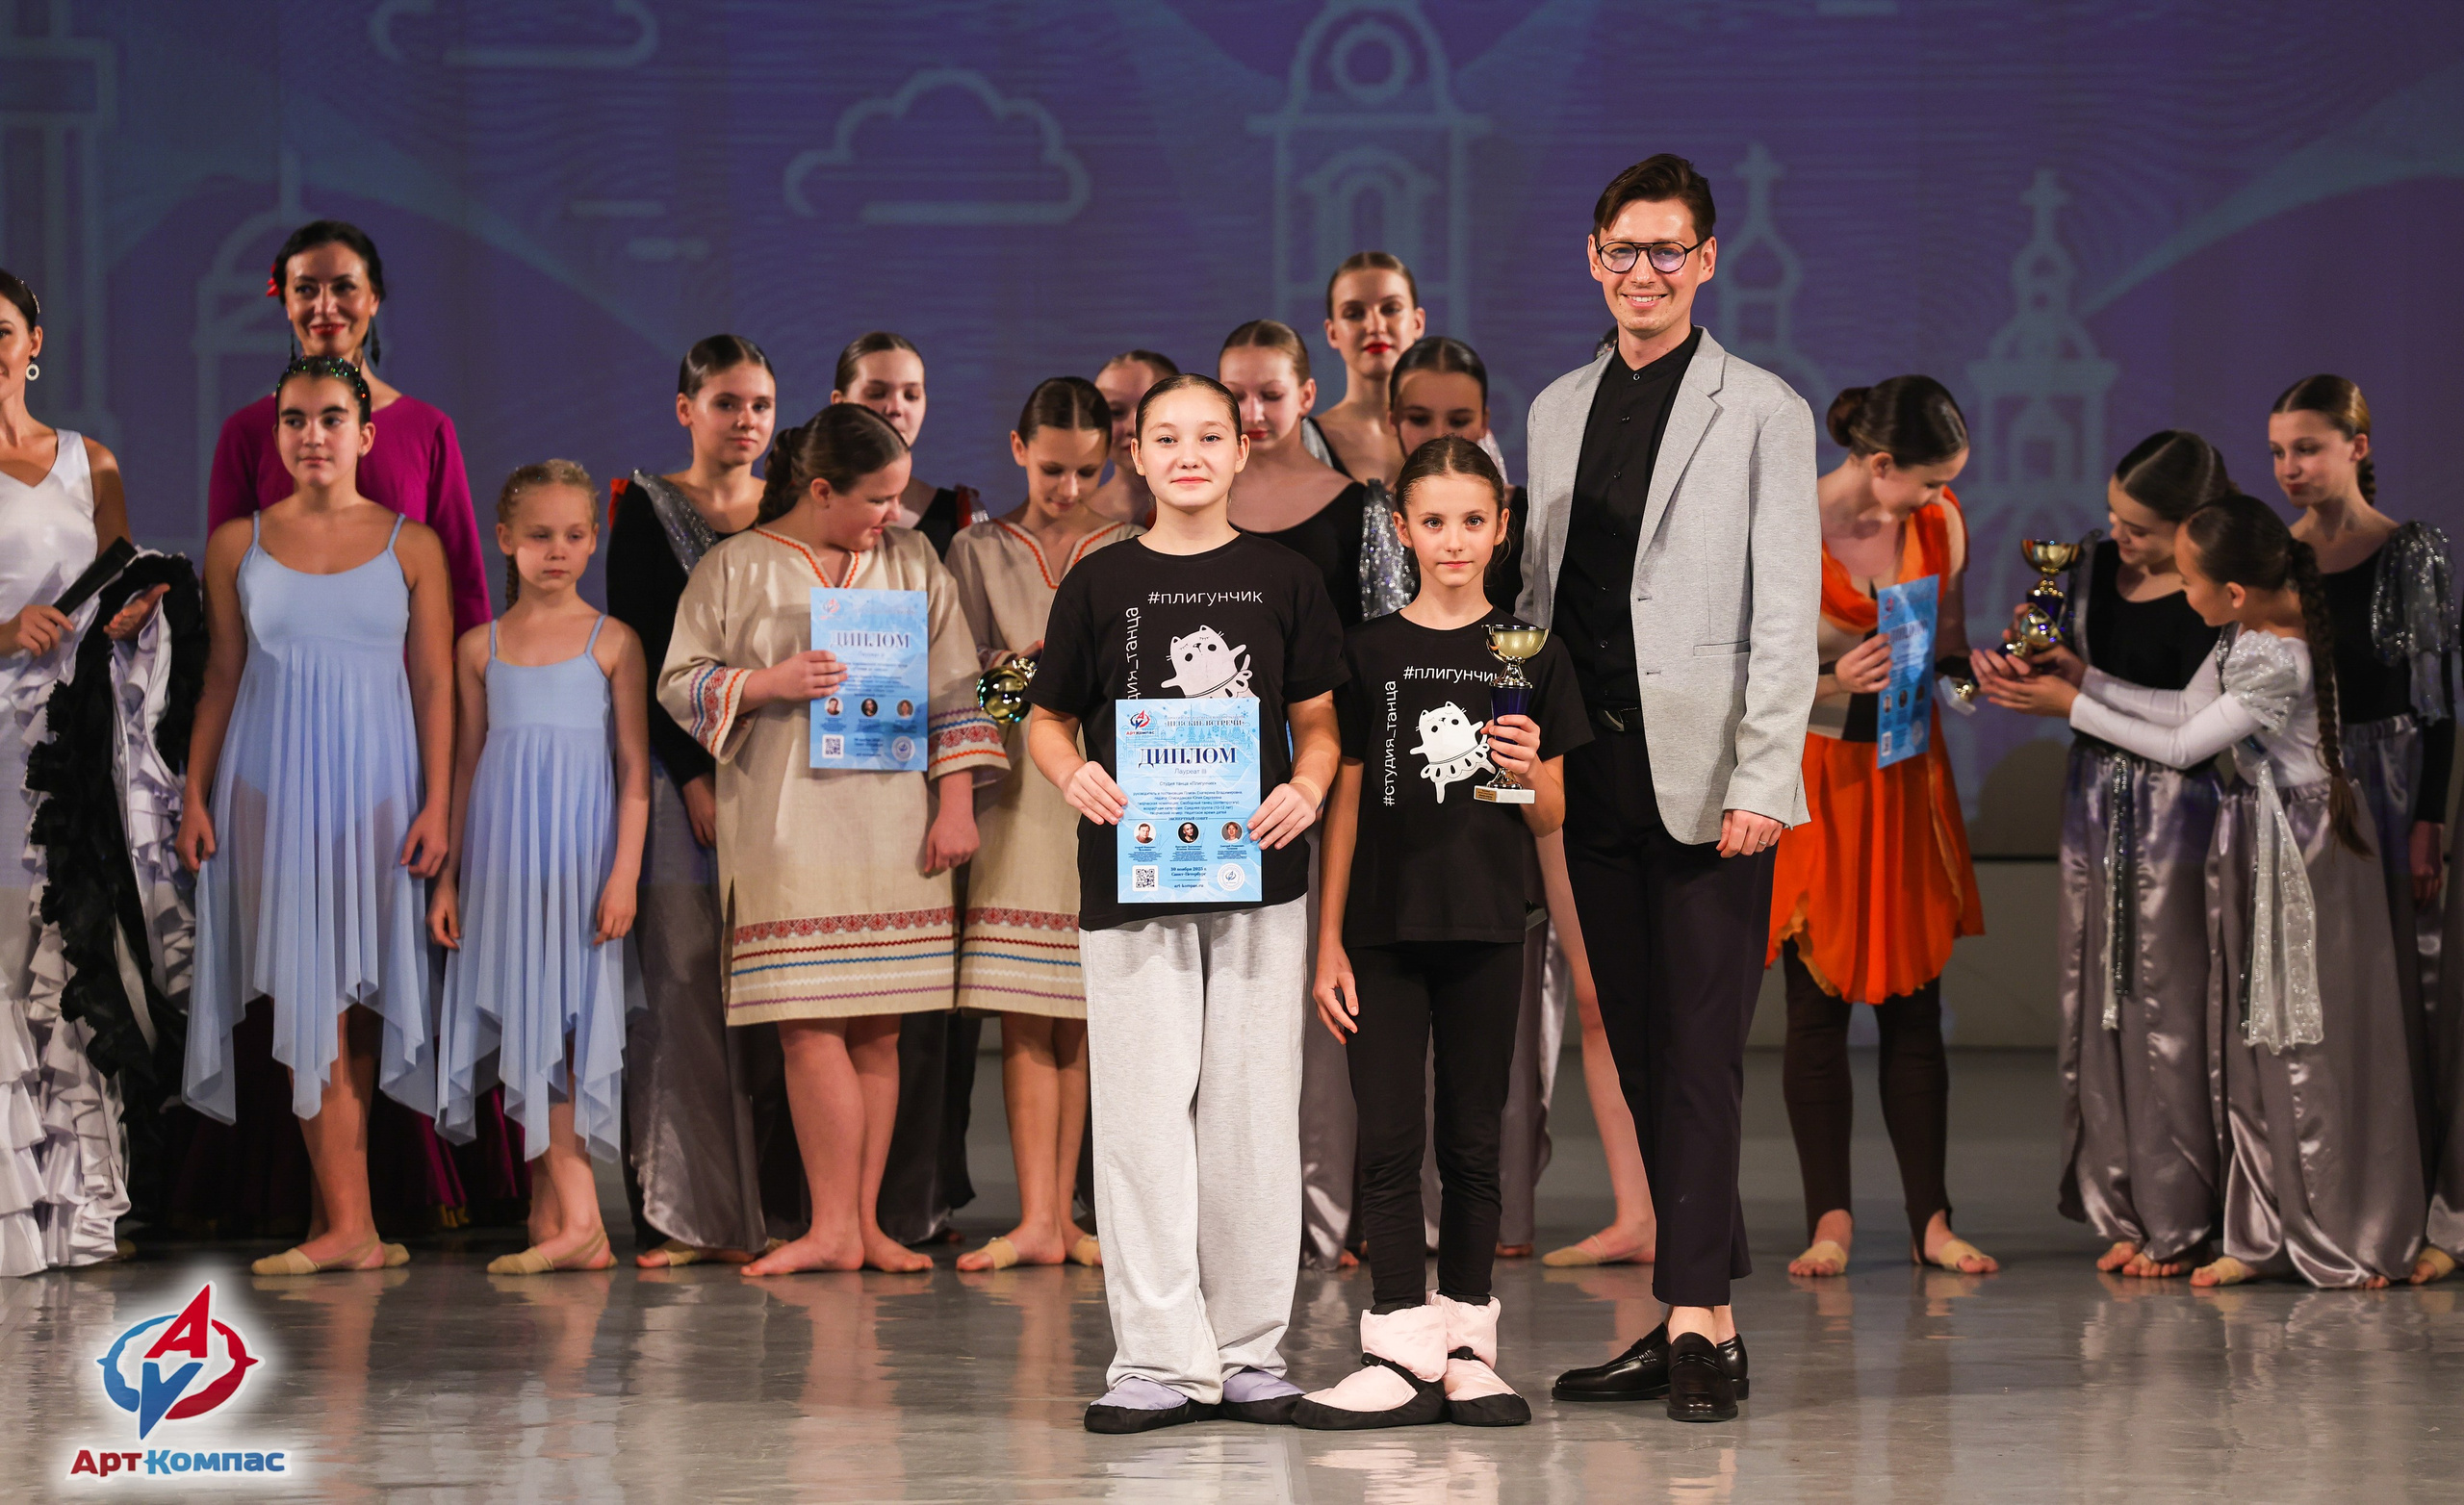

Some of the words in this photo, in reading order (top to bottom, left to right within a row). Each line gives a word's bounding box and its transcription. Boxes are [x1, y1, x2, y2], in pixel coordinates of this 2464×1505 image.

[1147, 591, 1263, 606] #плигунчик
[830, 631, 910, 649] ДИПЛОМ
[1125, 607, 1142, 700] дия_танца
[1403, 666, 1498, 683] #плигунчи
[1383, 680, 1399, 806] #студия_танца
[1138, 747, 1238, 768] ДИПЛОМ
